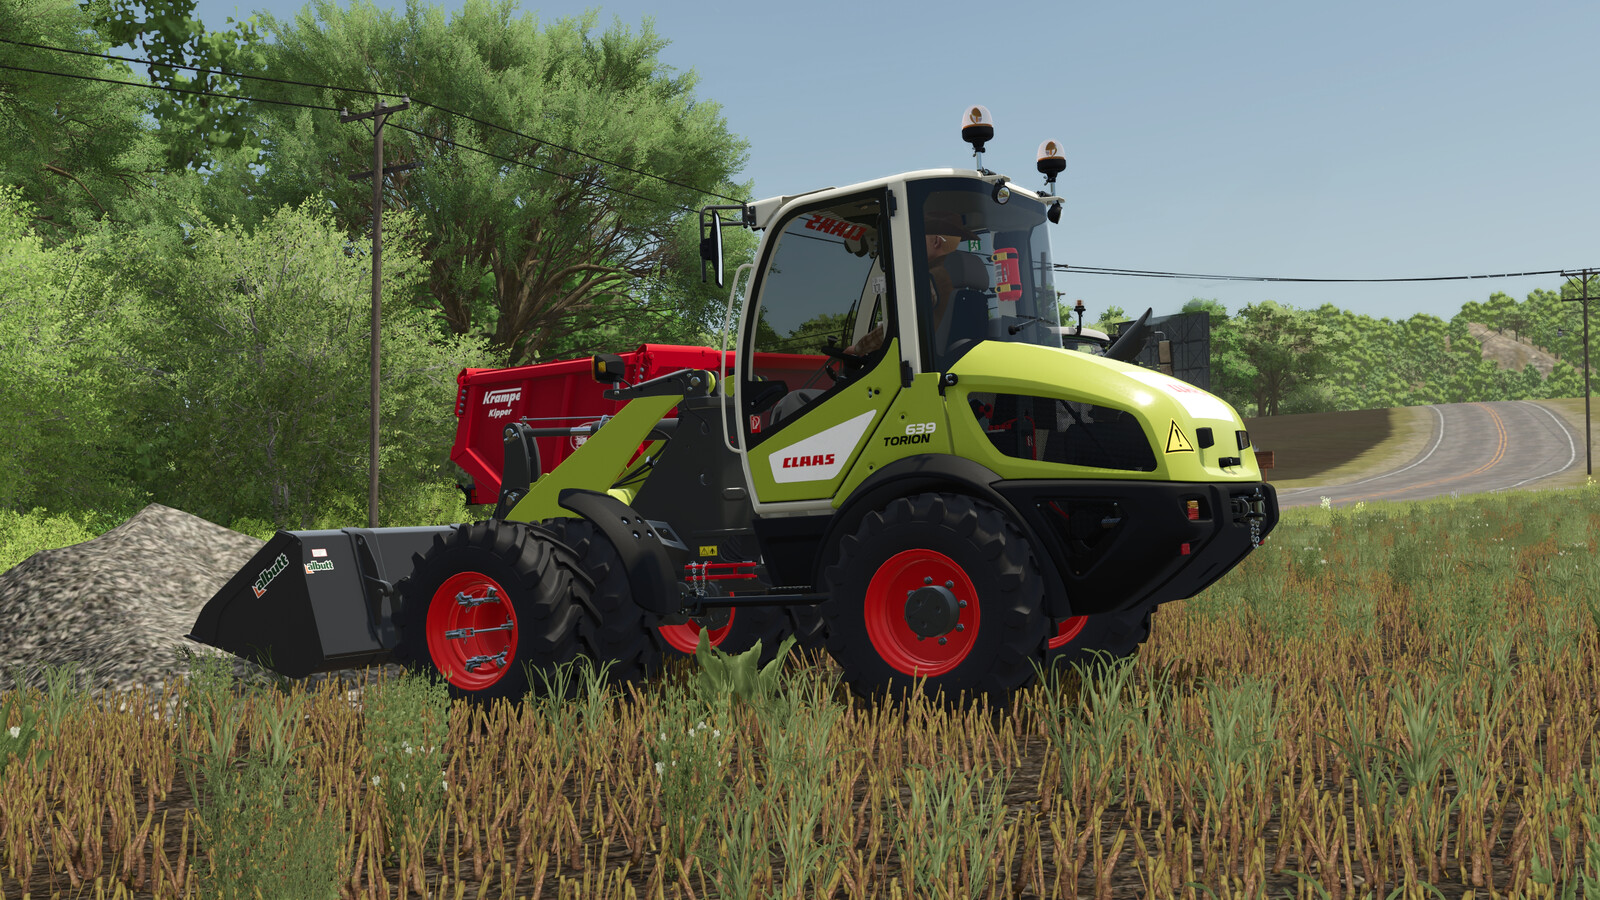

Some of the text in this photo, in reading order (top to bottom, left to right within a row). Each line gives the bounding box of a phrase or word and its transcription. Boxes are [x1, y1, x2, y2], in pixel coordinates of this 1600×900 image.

[483, 388, 522, 407] Krampe
[488, 408, 512, 419] Kipper
[905, 422, 936, 435] 639
[884, 434, 931, 447] TORION
[782, 454, 835, 468] CLAAS
[255, 553, 290, 591] albutt
[307, 560, 334, 571] albutt
